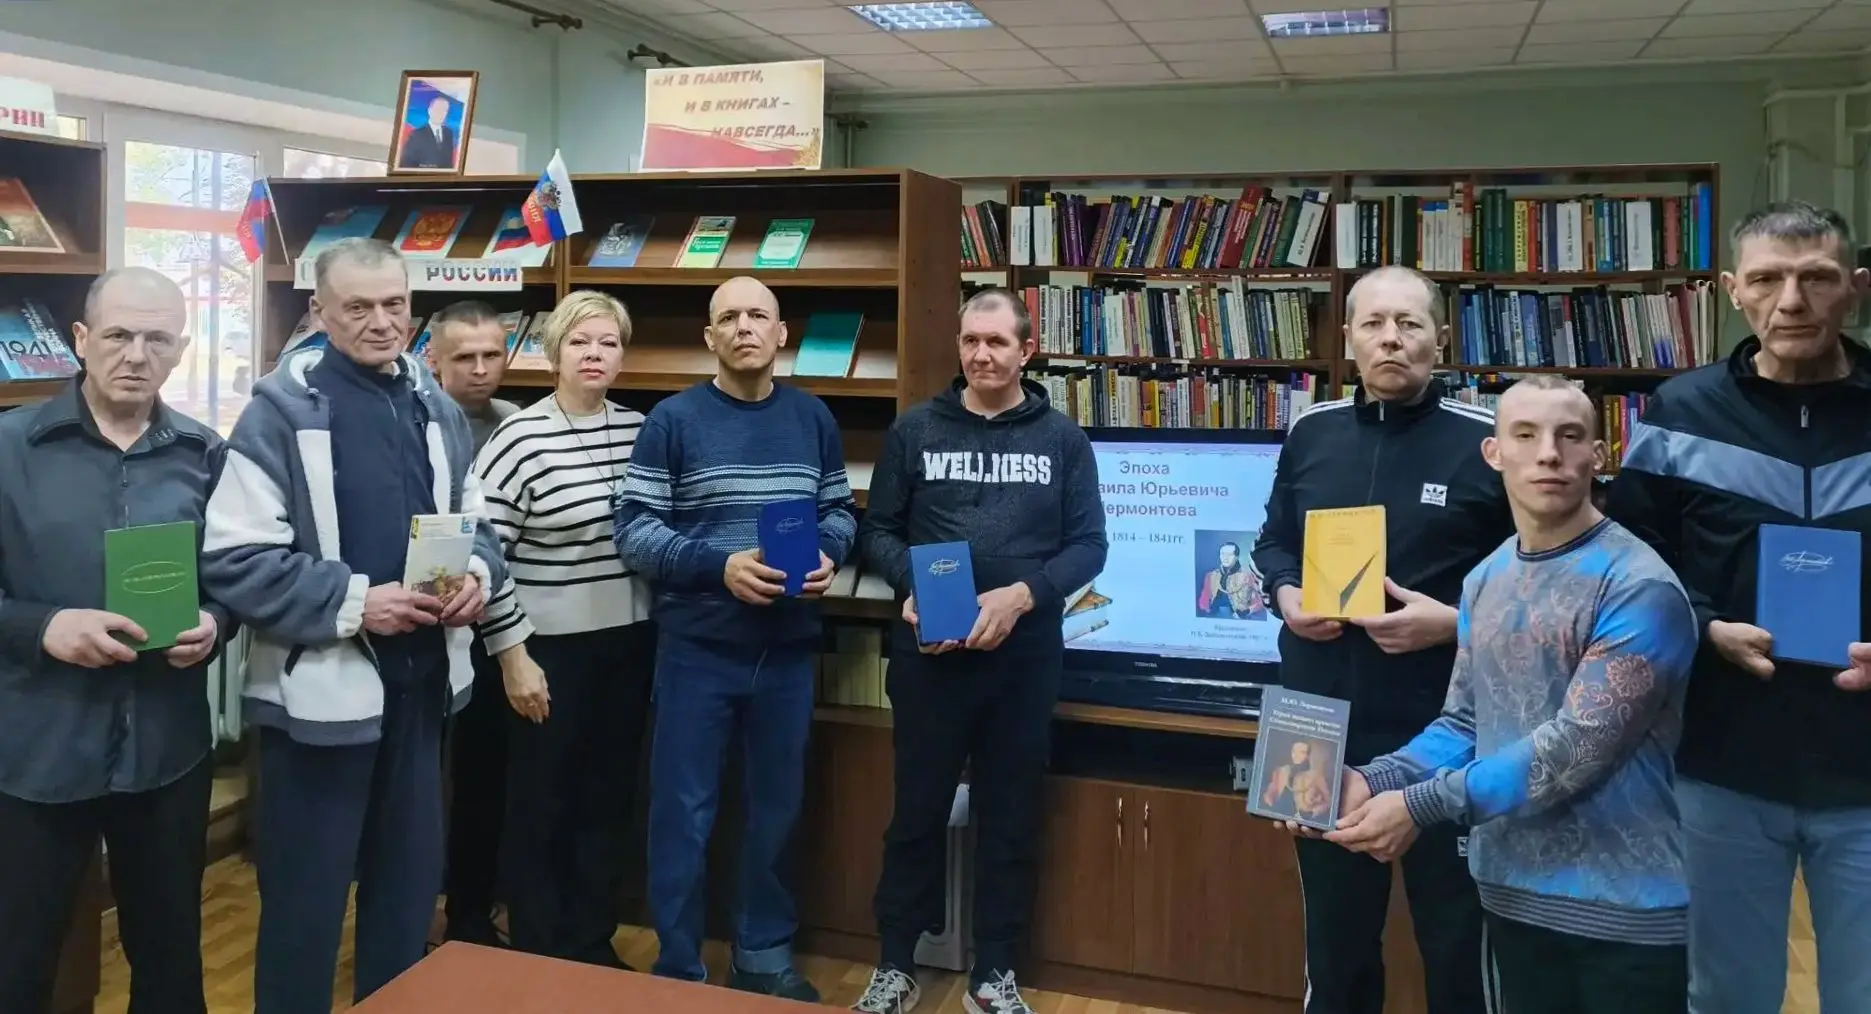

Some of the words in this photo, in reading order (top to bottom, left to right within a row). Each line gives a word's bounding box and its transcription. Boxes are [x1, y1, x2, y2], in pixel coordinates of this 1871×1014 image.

[653, 73, 673, 87] «И
[678, 74, 690, 86] В
[693, 69, 764, 86] ПАМЯТИ,
[684, 101, 697, 113] И
[700, 100, 712, 112] В
[715, 96, 780, 112] КНИГАХ
[426, 265, 518, 282] РОССИИ
[1119, 460, 1170, 475] Эпоха
[1098, 483, 1136, 495] аила
[1140, 481, 1229, 498] Юрьевича
[1102, 501, 1197, 518] ермонтова
[1112, 532, 1136, 542] 1814
